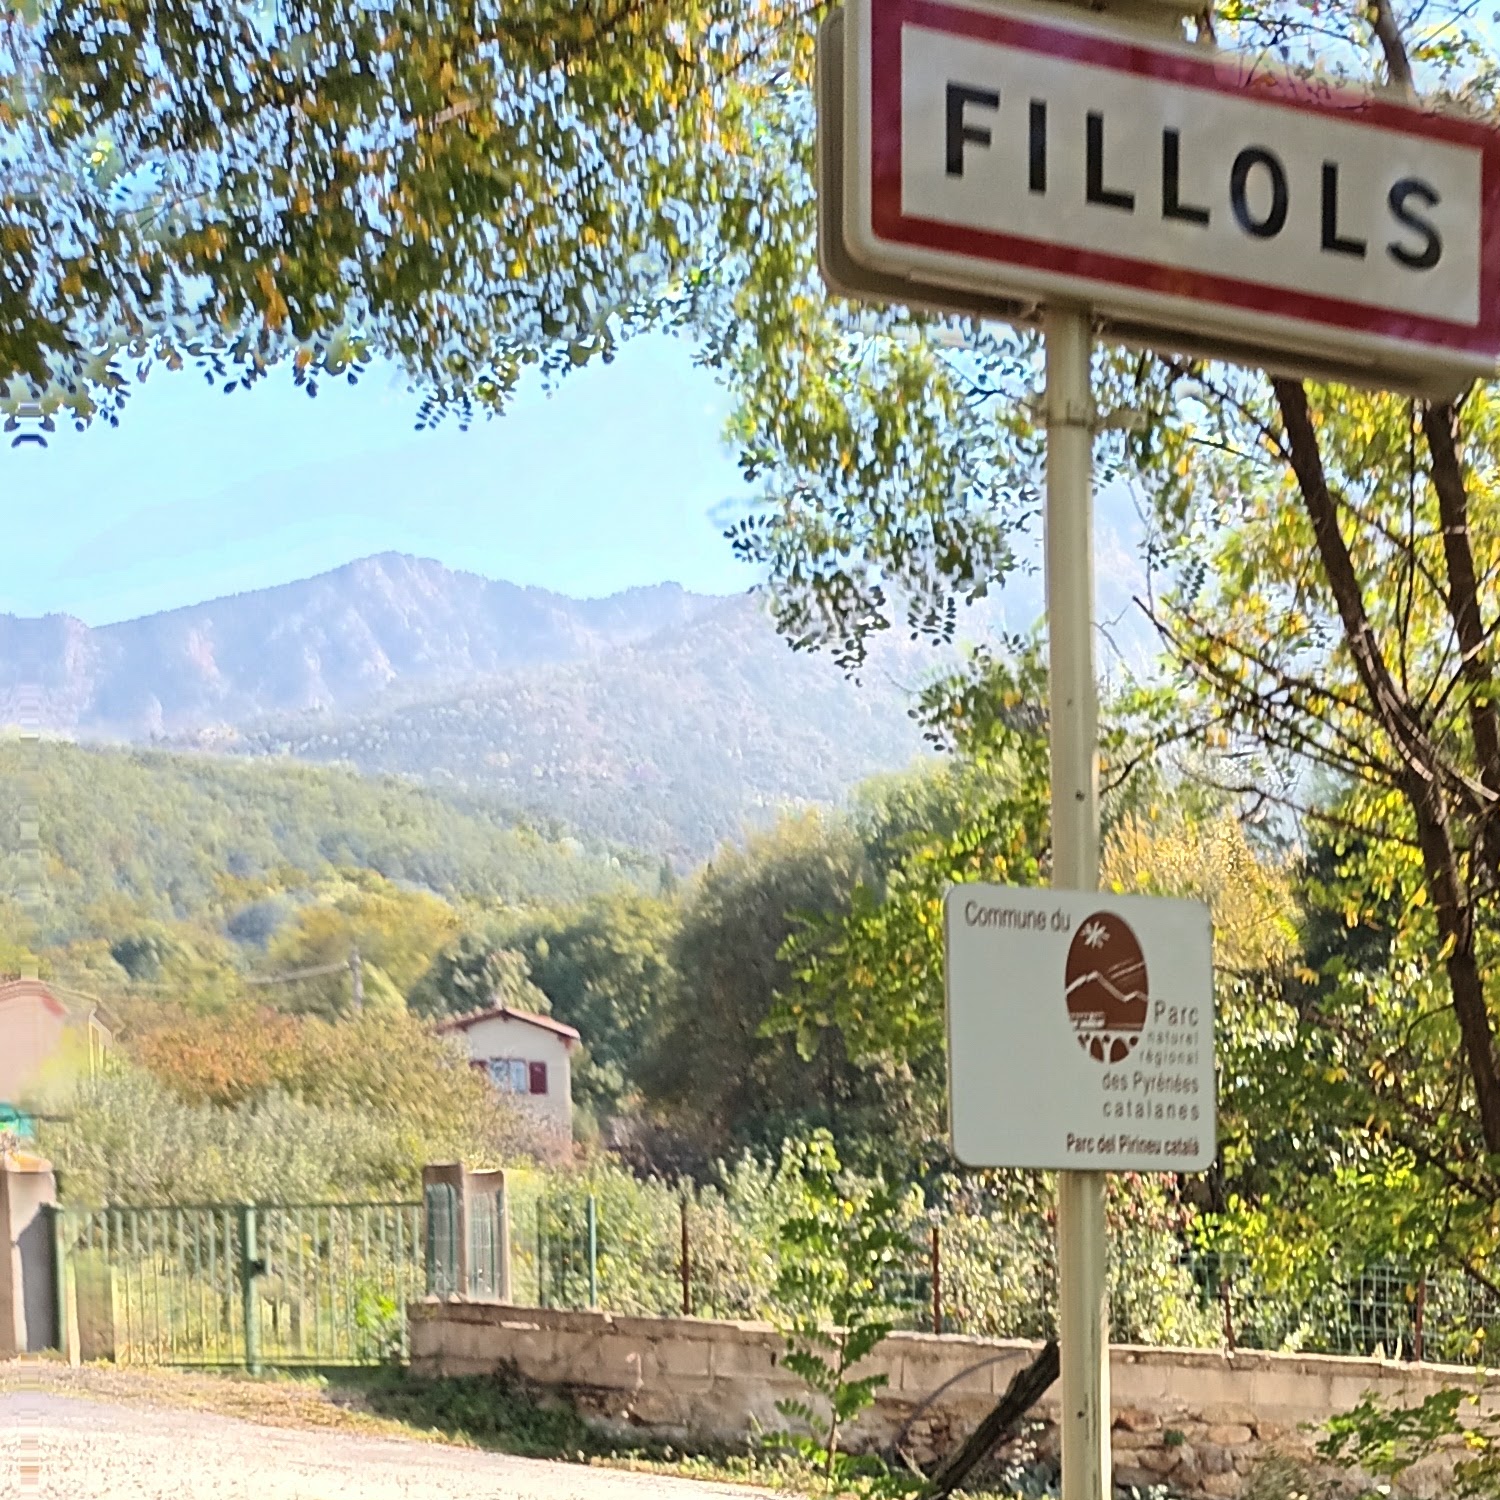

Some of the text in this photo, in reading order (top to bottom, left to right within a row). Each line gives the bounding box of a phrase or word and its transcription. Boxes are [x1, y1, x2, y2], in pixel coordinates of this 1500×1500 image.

[944, 81, 1444, 271] FILLOLS
[965, 899, 1072, 933] Commune du
[1153, 999, 1200, 1027] Parc
[1102, 1069, 1200, 1097] des Pyrénées
[1102, 1098, 1201, 1121] catalanes
[1066, 1131, 1095, 1154] Parc
[1097, 1133, 1117, 1155] del
